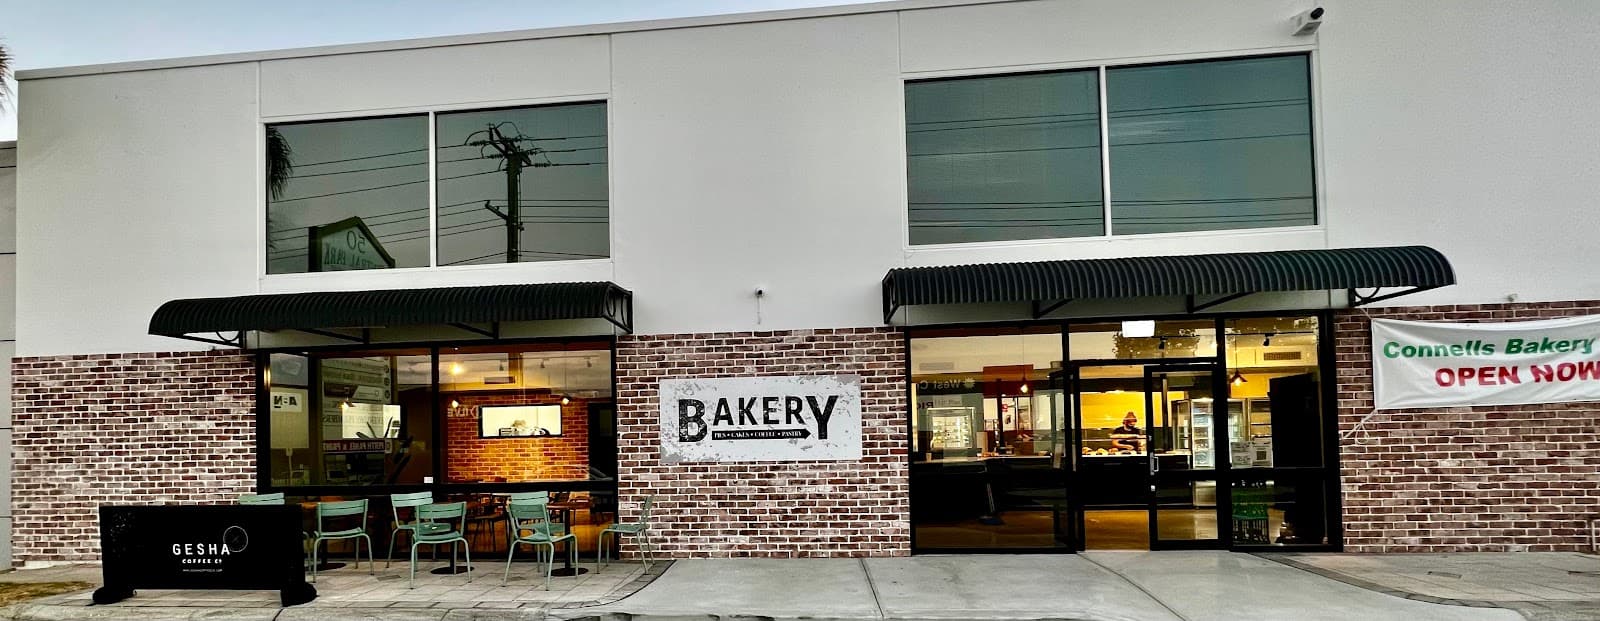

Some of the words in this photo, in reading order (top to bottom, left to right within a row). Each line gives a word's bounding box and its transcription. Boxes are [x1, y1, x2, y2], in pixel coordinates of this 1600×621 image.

[1383, 339, 1496, 359] Connells
[1505, 336, 1596, 355] Bakery
[1435, 365, 1521, 387] OPEN
[1530, 361, 1600, 382] NOW
[678, 395, 839, 442] BAKERY
[754, 430, 776, 438] COFFEE
[172, 543, 230, 555] GESHA
